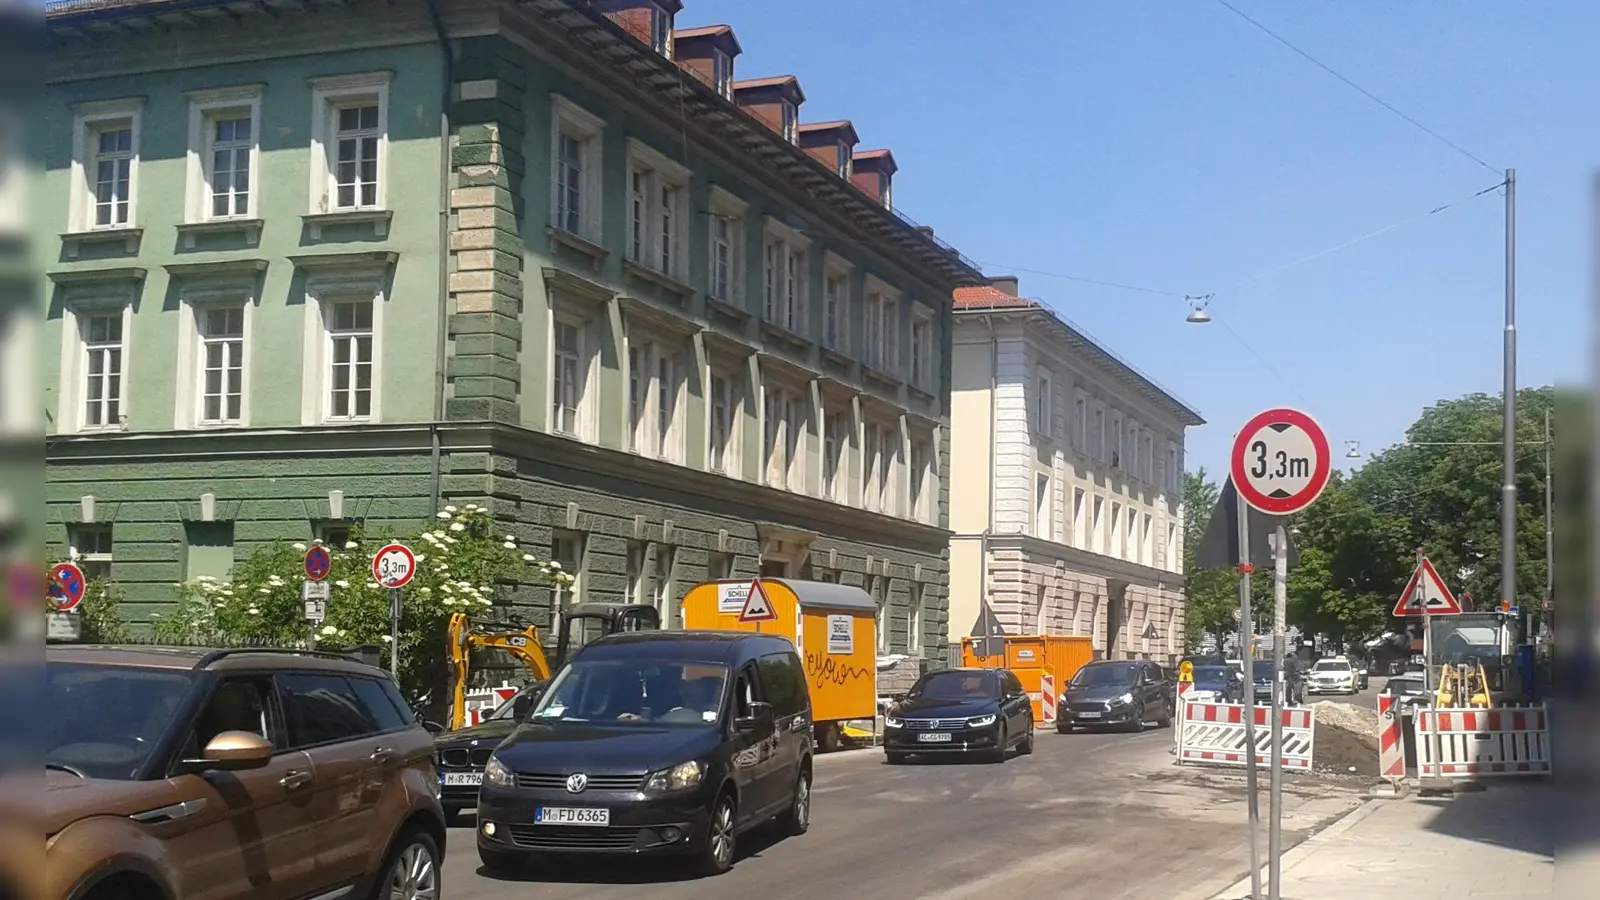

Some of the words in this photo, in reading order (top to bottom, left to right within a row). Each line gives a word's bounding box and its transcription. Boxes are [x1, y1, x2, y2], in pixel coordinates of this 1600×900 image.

[1251, 440, 1309, 480] 3,3m
[458, 774, 464, 784] R
[466, 774, 484, 784] 796
[543, 808, 552, 821] M
[559, 809, 575, 822] FD
[577, 810, 607, 822] 6365
